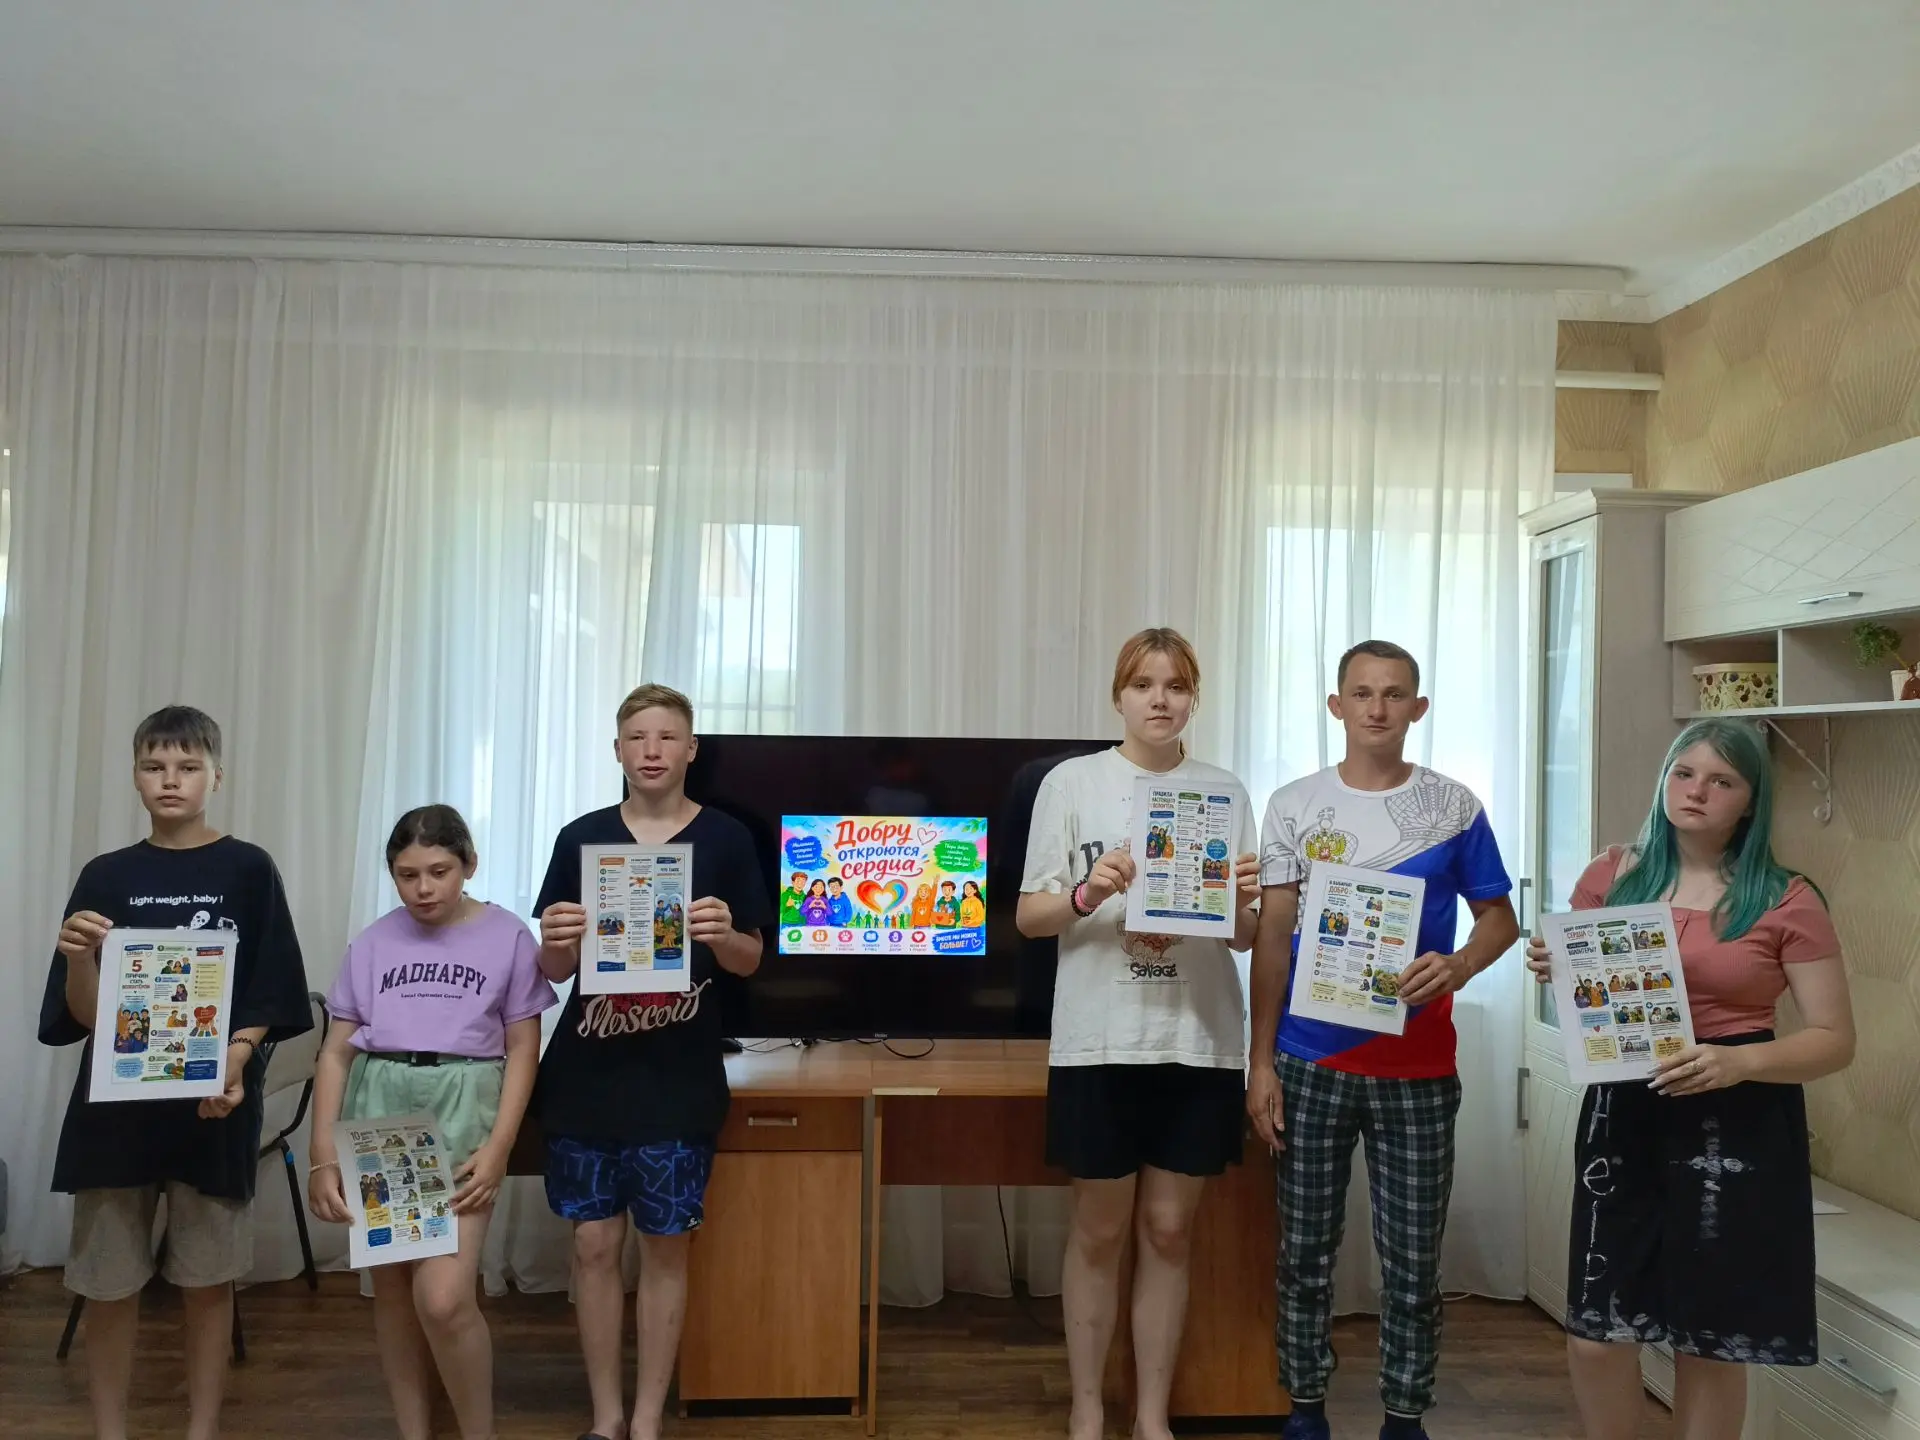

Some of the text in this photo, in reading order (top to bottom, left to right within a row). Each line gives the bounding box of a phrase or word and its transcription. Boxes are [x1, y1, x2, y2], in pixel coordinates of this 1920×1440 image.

[834, 819, 913, 849] Добру
[838, 846, 919, 862] откроются
[841, 859, 922, 880] сердца
[129, 896, 154, 906] Light
[155, 895, 191, 906] weight,
[192, 894, 218, 905] baby
[132, 959, 143, 972] 5
[379, 963, 487, 995] MADHAPPY
[577, 978, 712, 1038] Moscow
